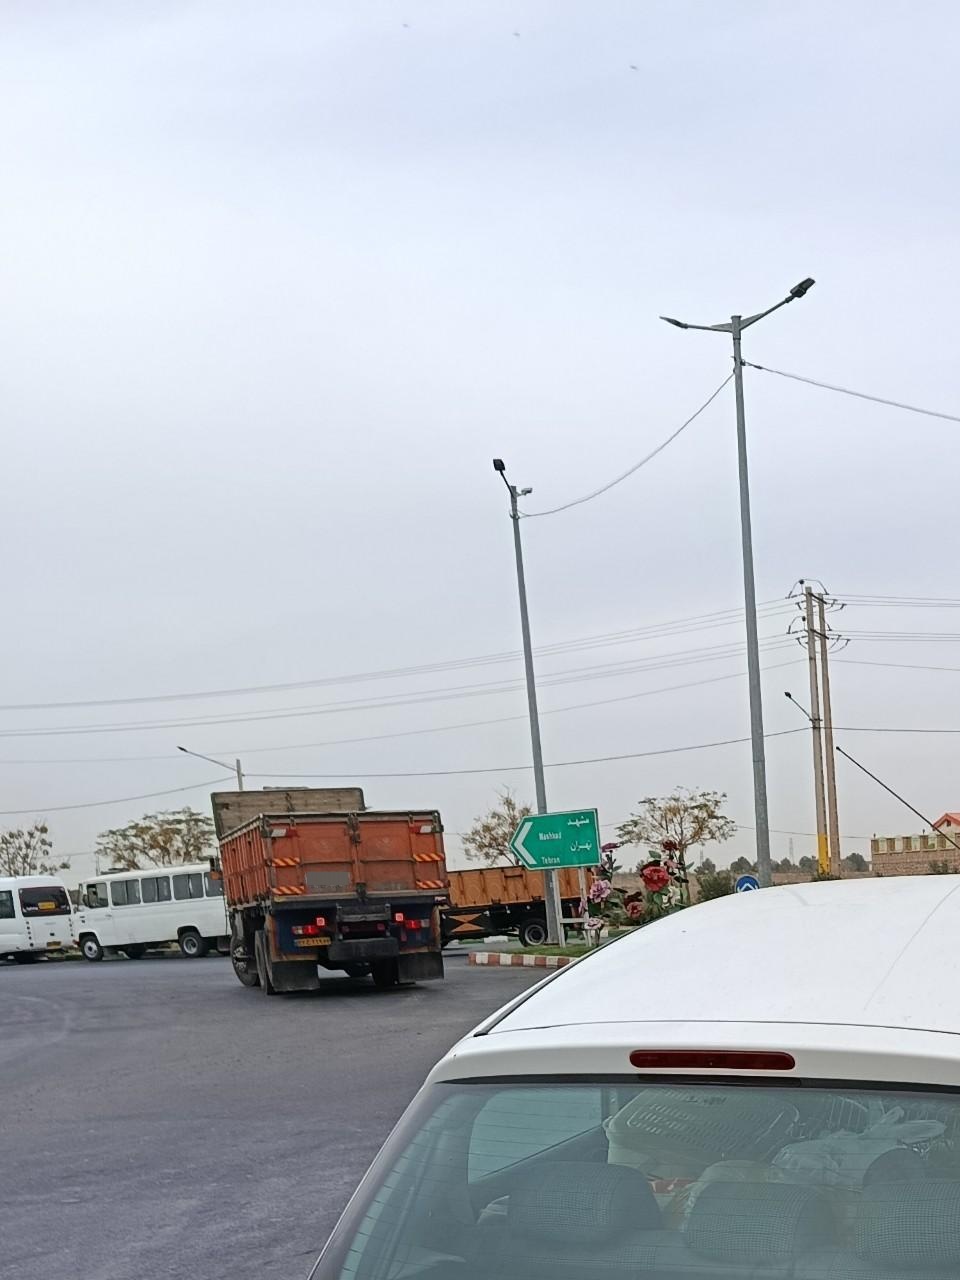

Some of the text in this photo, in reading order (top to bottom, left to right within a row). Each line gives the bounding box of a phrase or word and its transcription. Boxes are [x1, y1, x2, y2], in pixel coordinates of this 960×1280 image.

[567, 816, 590, 827] مشهد
[570, 840, 592, 852] تهران
[541, 856, 560, 864] Tehran
